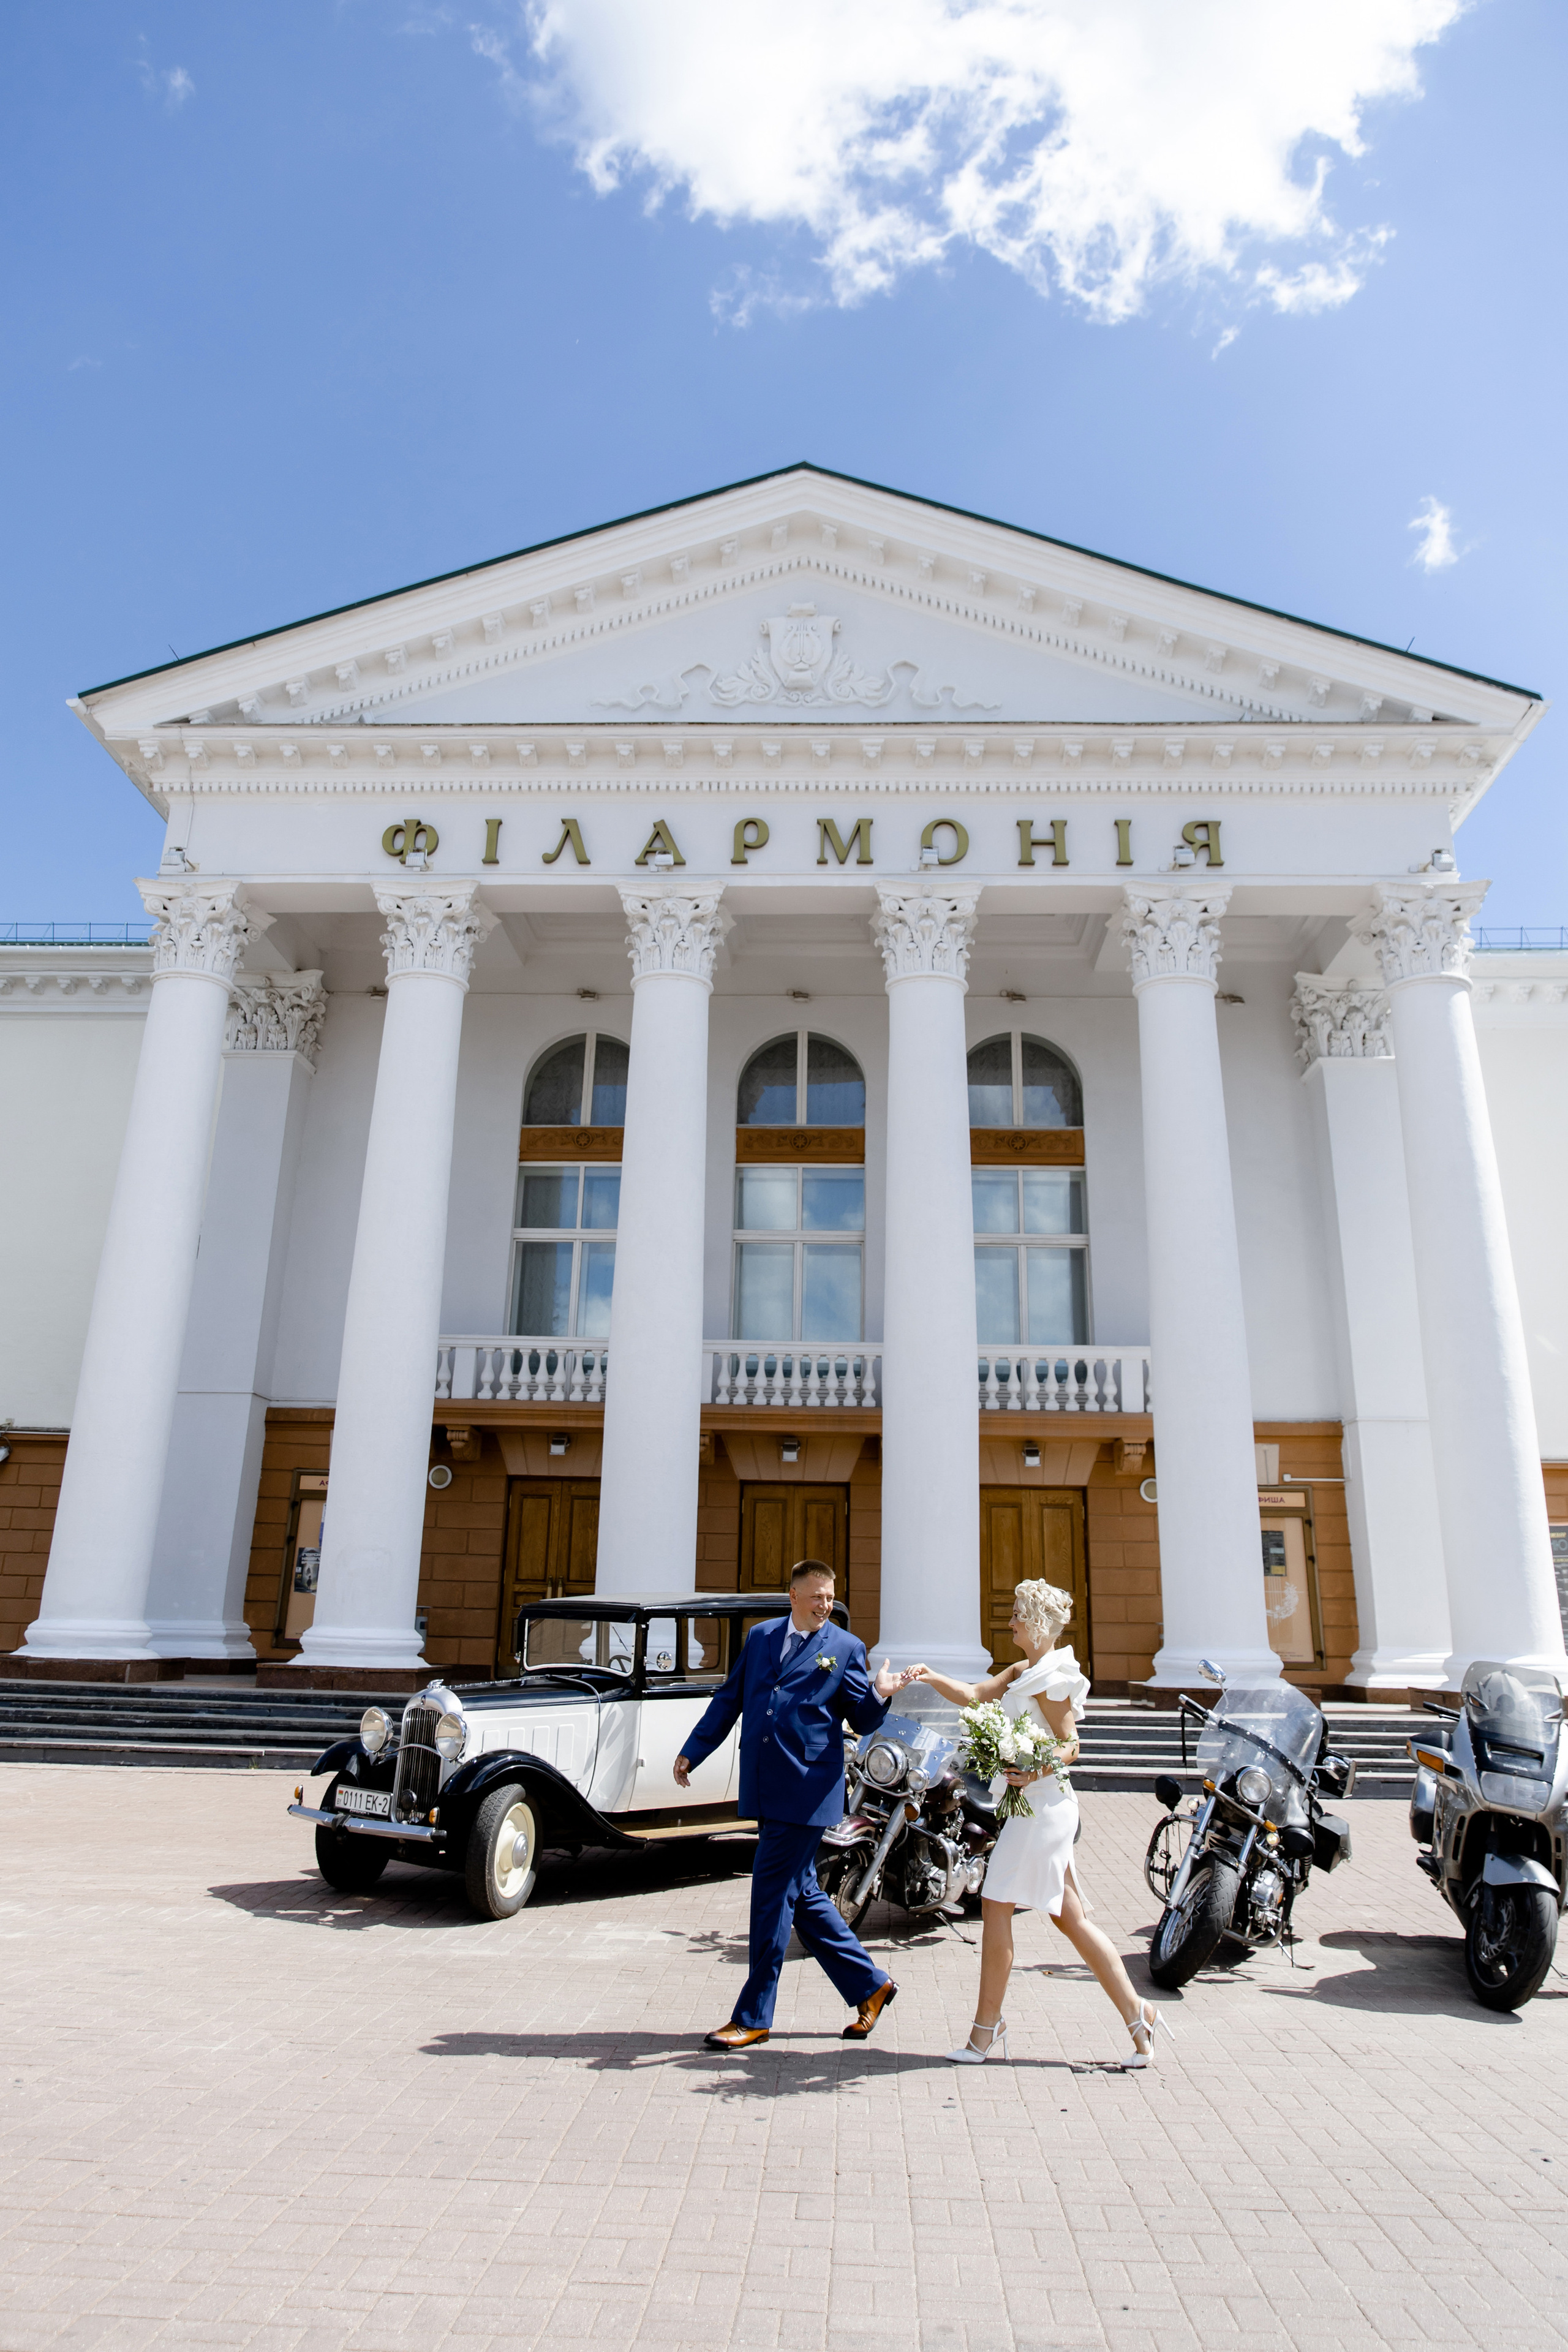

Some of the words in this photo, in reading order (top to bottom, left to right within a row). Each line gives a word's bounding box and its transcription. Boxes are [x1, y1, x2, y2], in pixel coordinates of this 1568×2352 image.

[382, 817, 1224, 866] ФІЛАРМОНІЯ
[343, 1790, 363, 1809] 0111
[365, 1794, 388, 1814] EK-2
[1158, 1910, 1169, 1932] METZ
